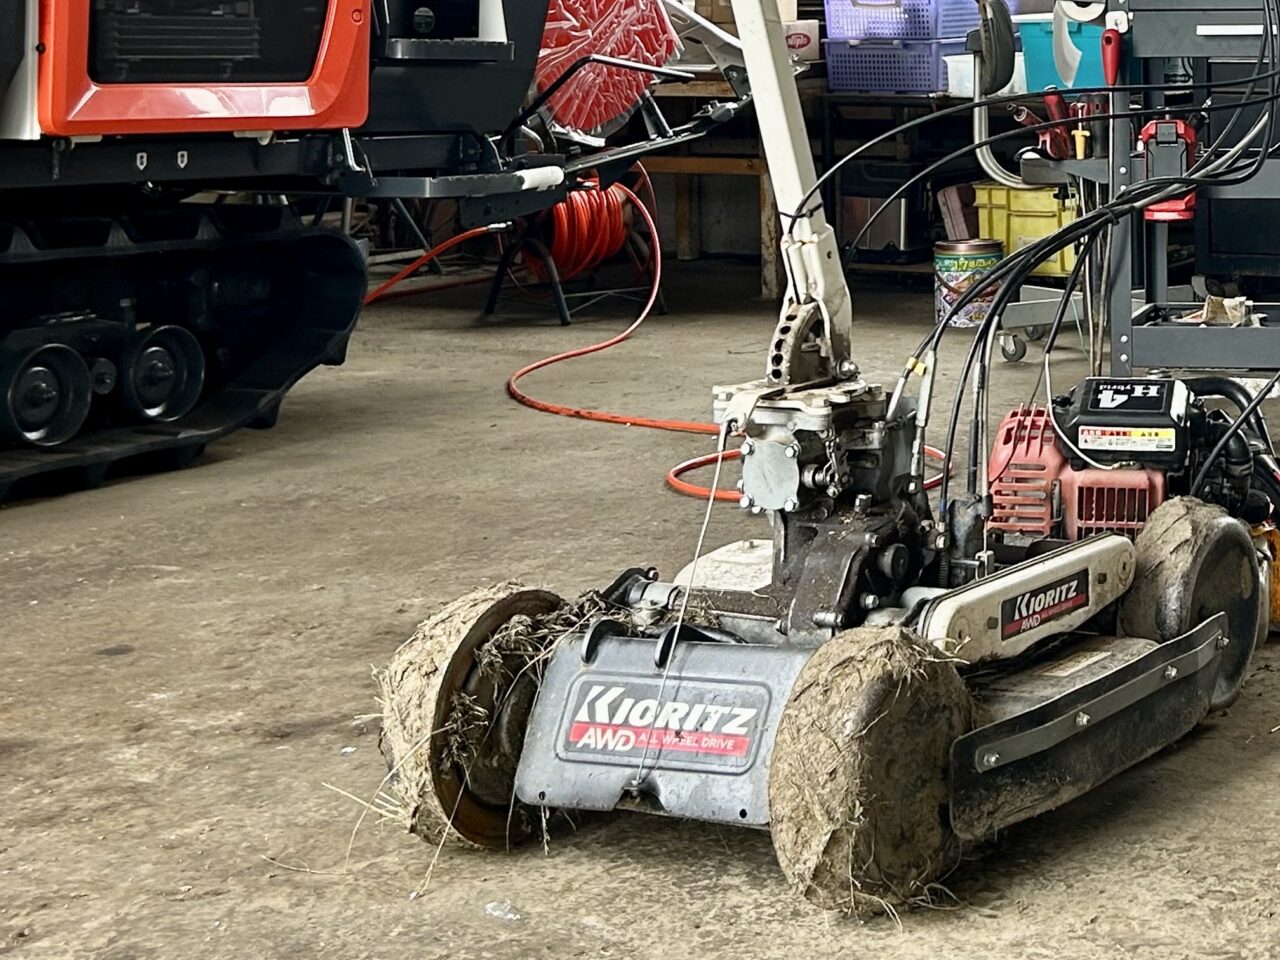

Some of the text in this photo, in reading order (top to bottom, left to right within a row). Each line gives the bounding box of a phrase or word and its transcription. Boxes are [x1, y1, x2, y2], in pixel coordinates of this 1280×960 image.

[1098, 390, 1129, 408] 4
[1099, 384, 1160, 397] Hybrid
[1014, 580, 1078, 620] KIORITZ
[1020, 614, 1040, 632] AWD
[575, 685, 757, 735] KIORITZ
[577, 727, 636, 751] AWD
[638, 732, 658, 743] ALL
[701, 737, 735, 750] DRIVE
